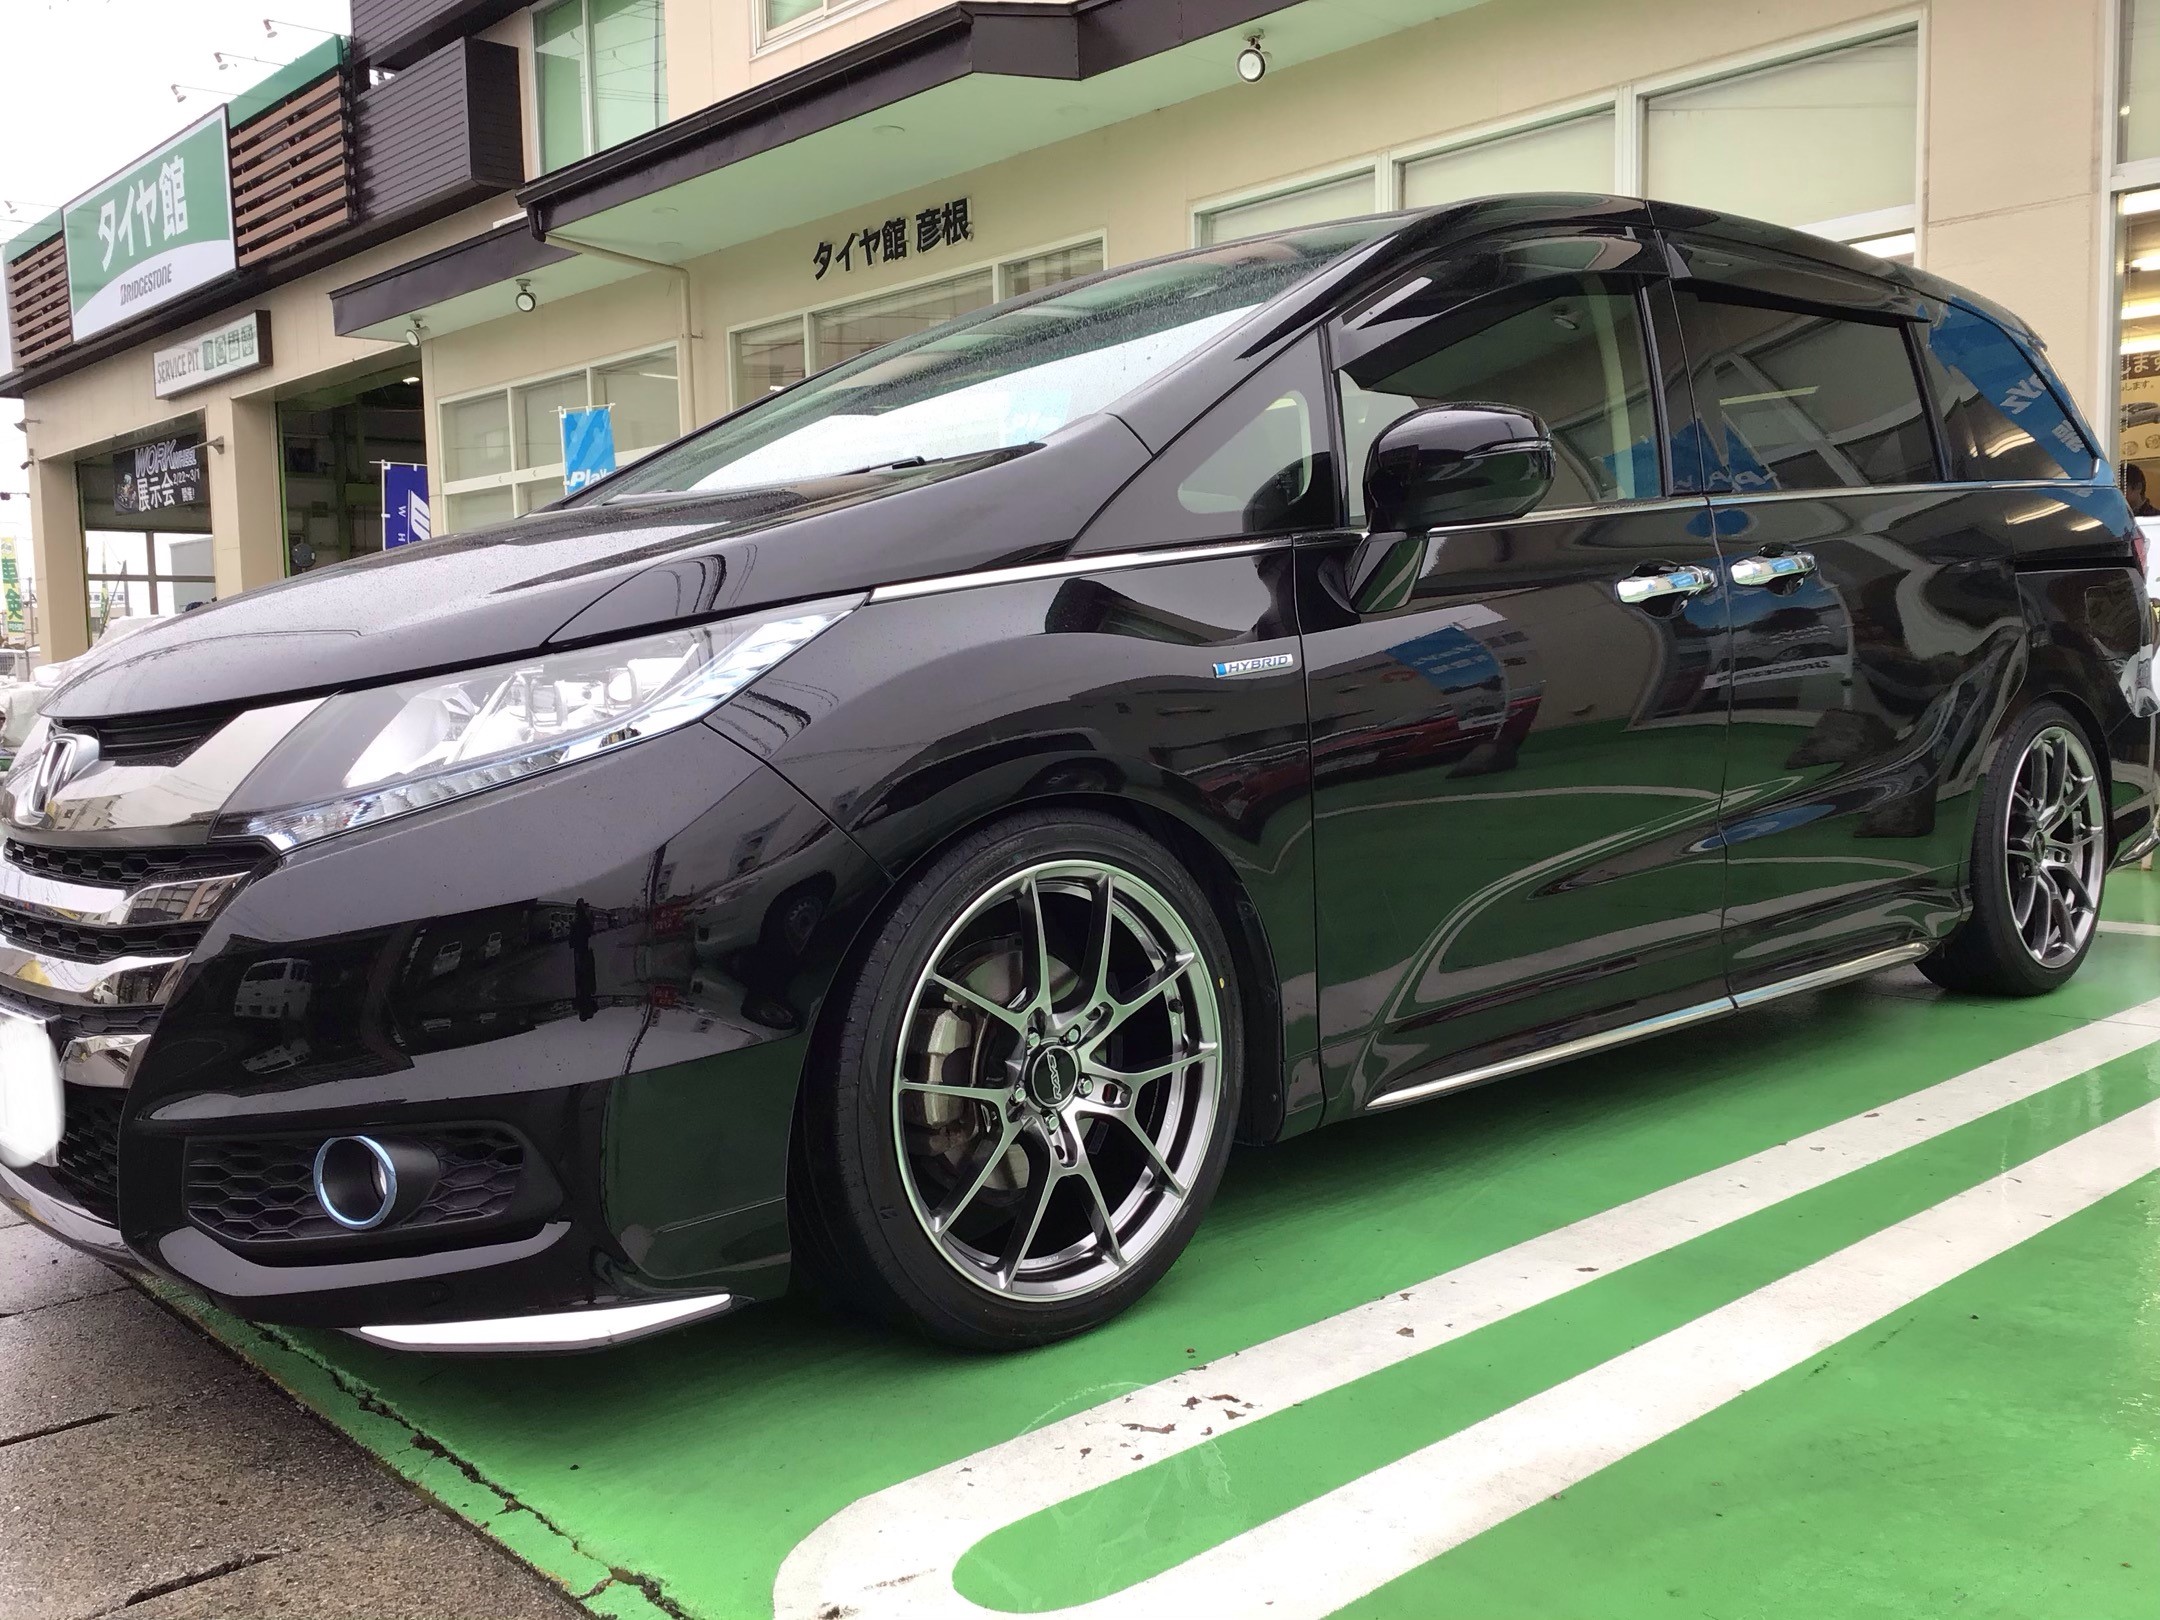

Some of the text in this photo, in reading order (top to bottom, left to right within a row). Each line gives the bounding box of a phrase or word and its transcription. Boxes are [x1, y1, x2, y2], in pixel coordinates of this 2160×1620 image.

[98, 154, 188, 273] タイヤ館
[812, 197, 970, 281] タイヤ館 彦根
[119, 262, 173, 307] BRIDGESTONE
[157, 346, 200, 384] SERVICE PIT
[135, 439, 176, 478] WORK
[136, 471, 175, 512] 展示会
[1228, 655, 1289, 674] HYBRID
[1046, 1052, 1063, 1101] RAYS
